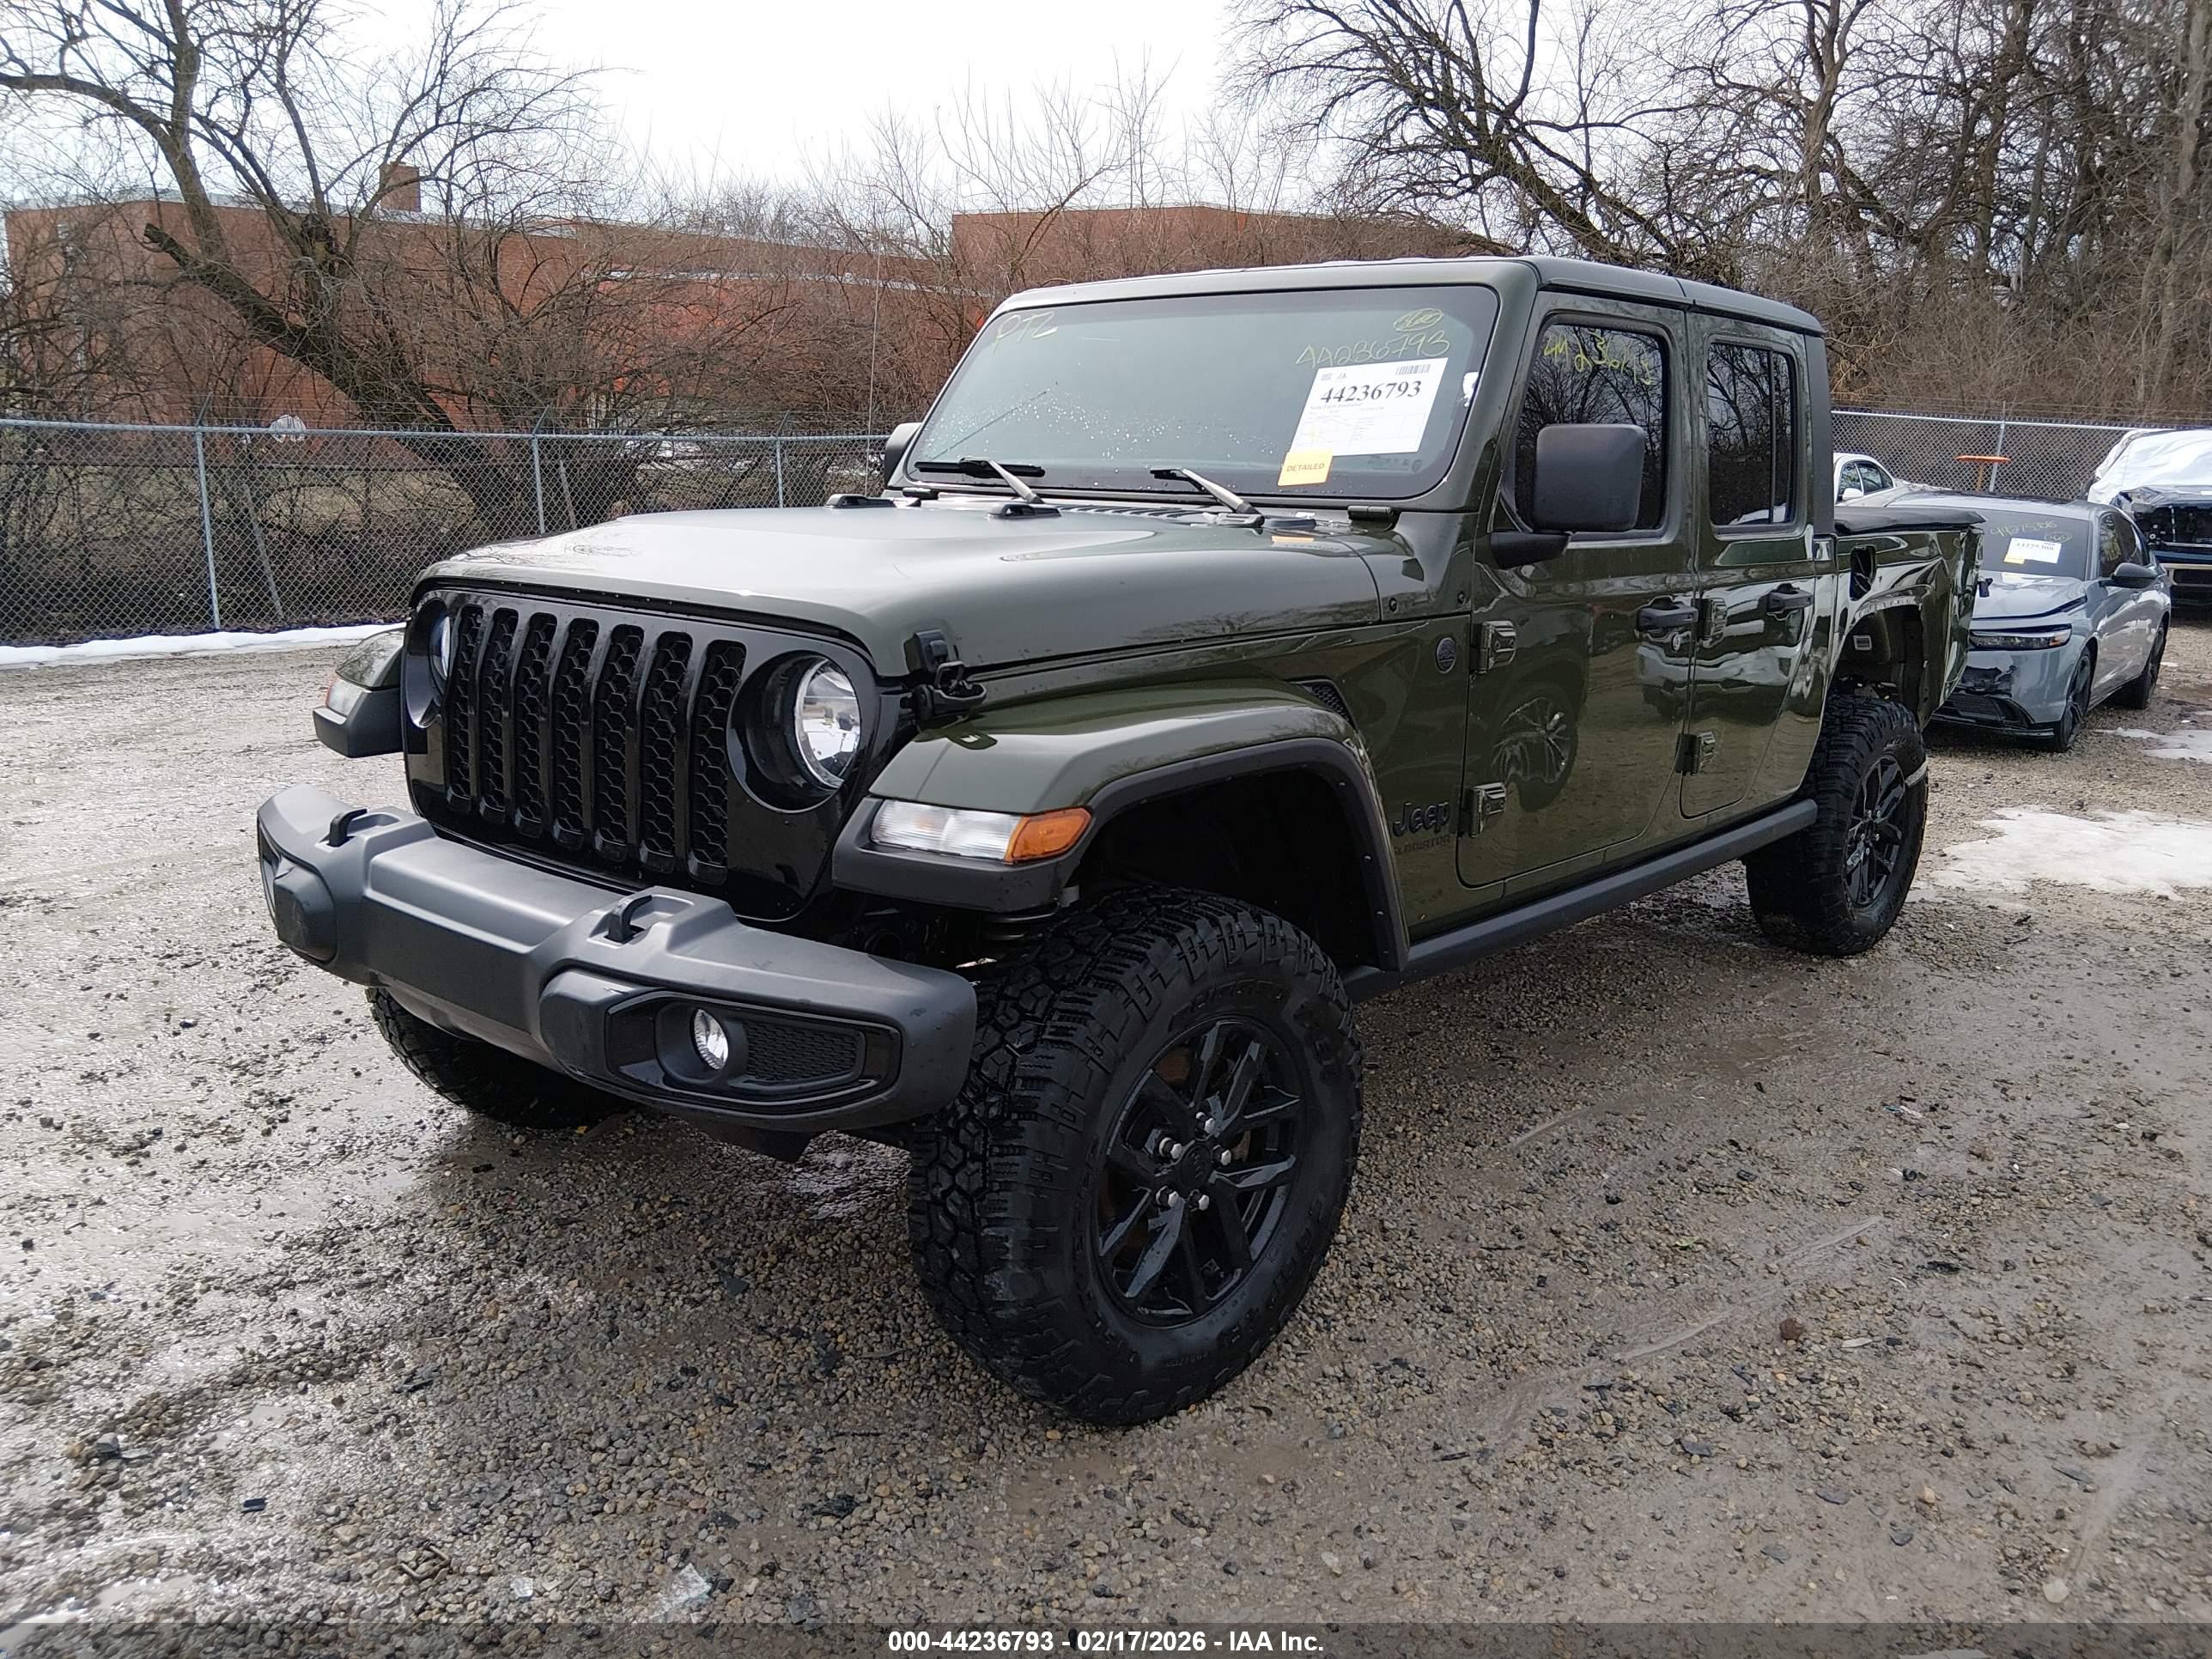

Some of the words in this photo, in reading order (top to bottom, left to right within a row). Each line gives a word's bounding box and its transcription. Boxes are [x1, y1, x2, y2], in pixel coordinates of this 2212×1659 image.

[1320, 380, 1422, 403] 44236793
[1286, 461, 1325, 473] DETAILED
[1393, 801, 1450, 837] Jeep
